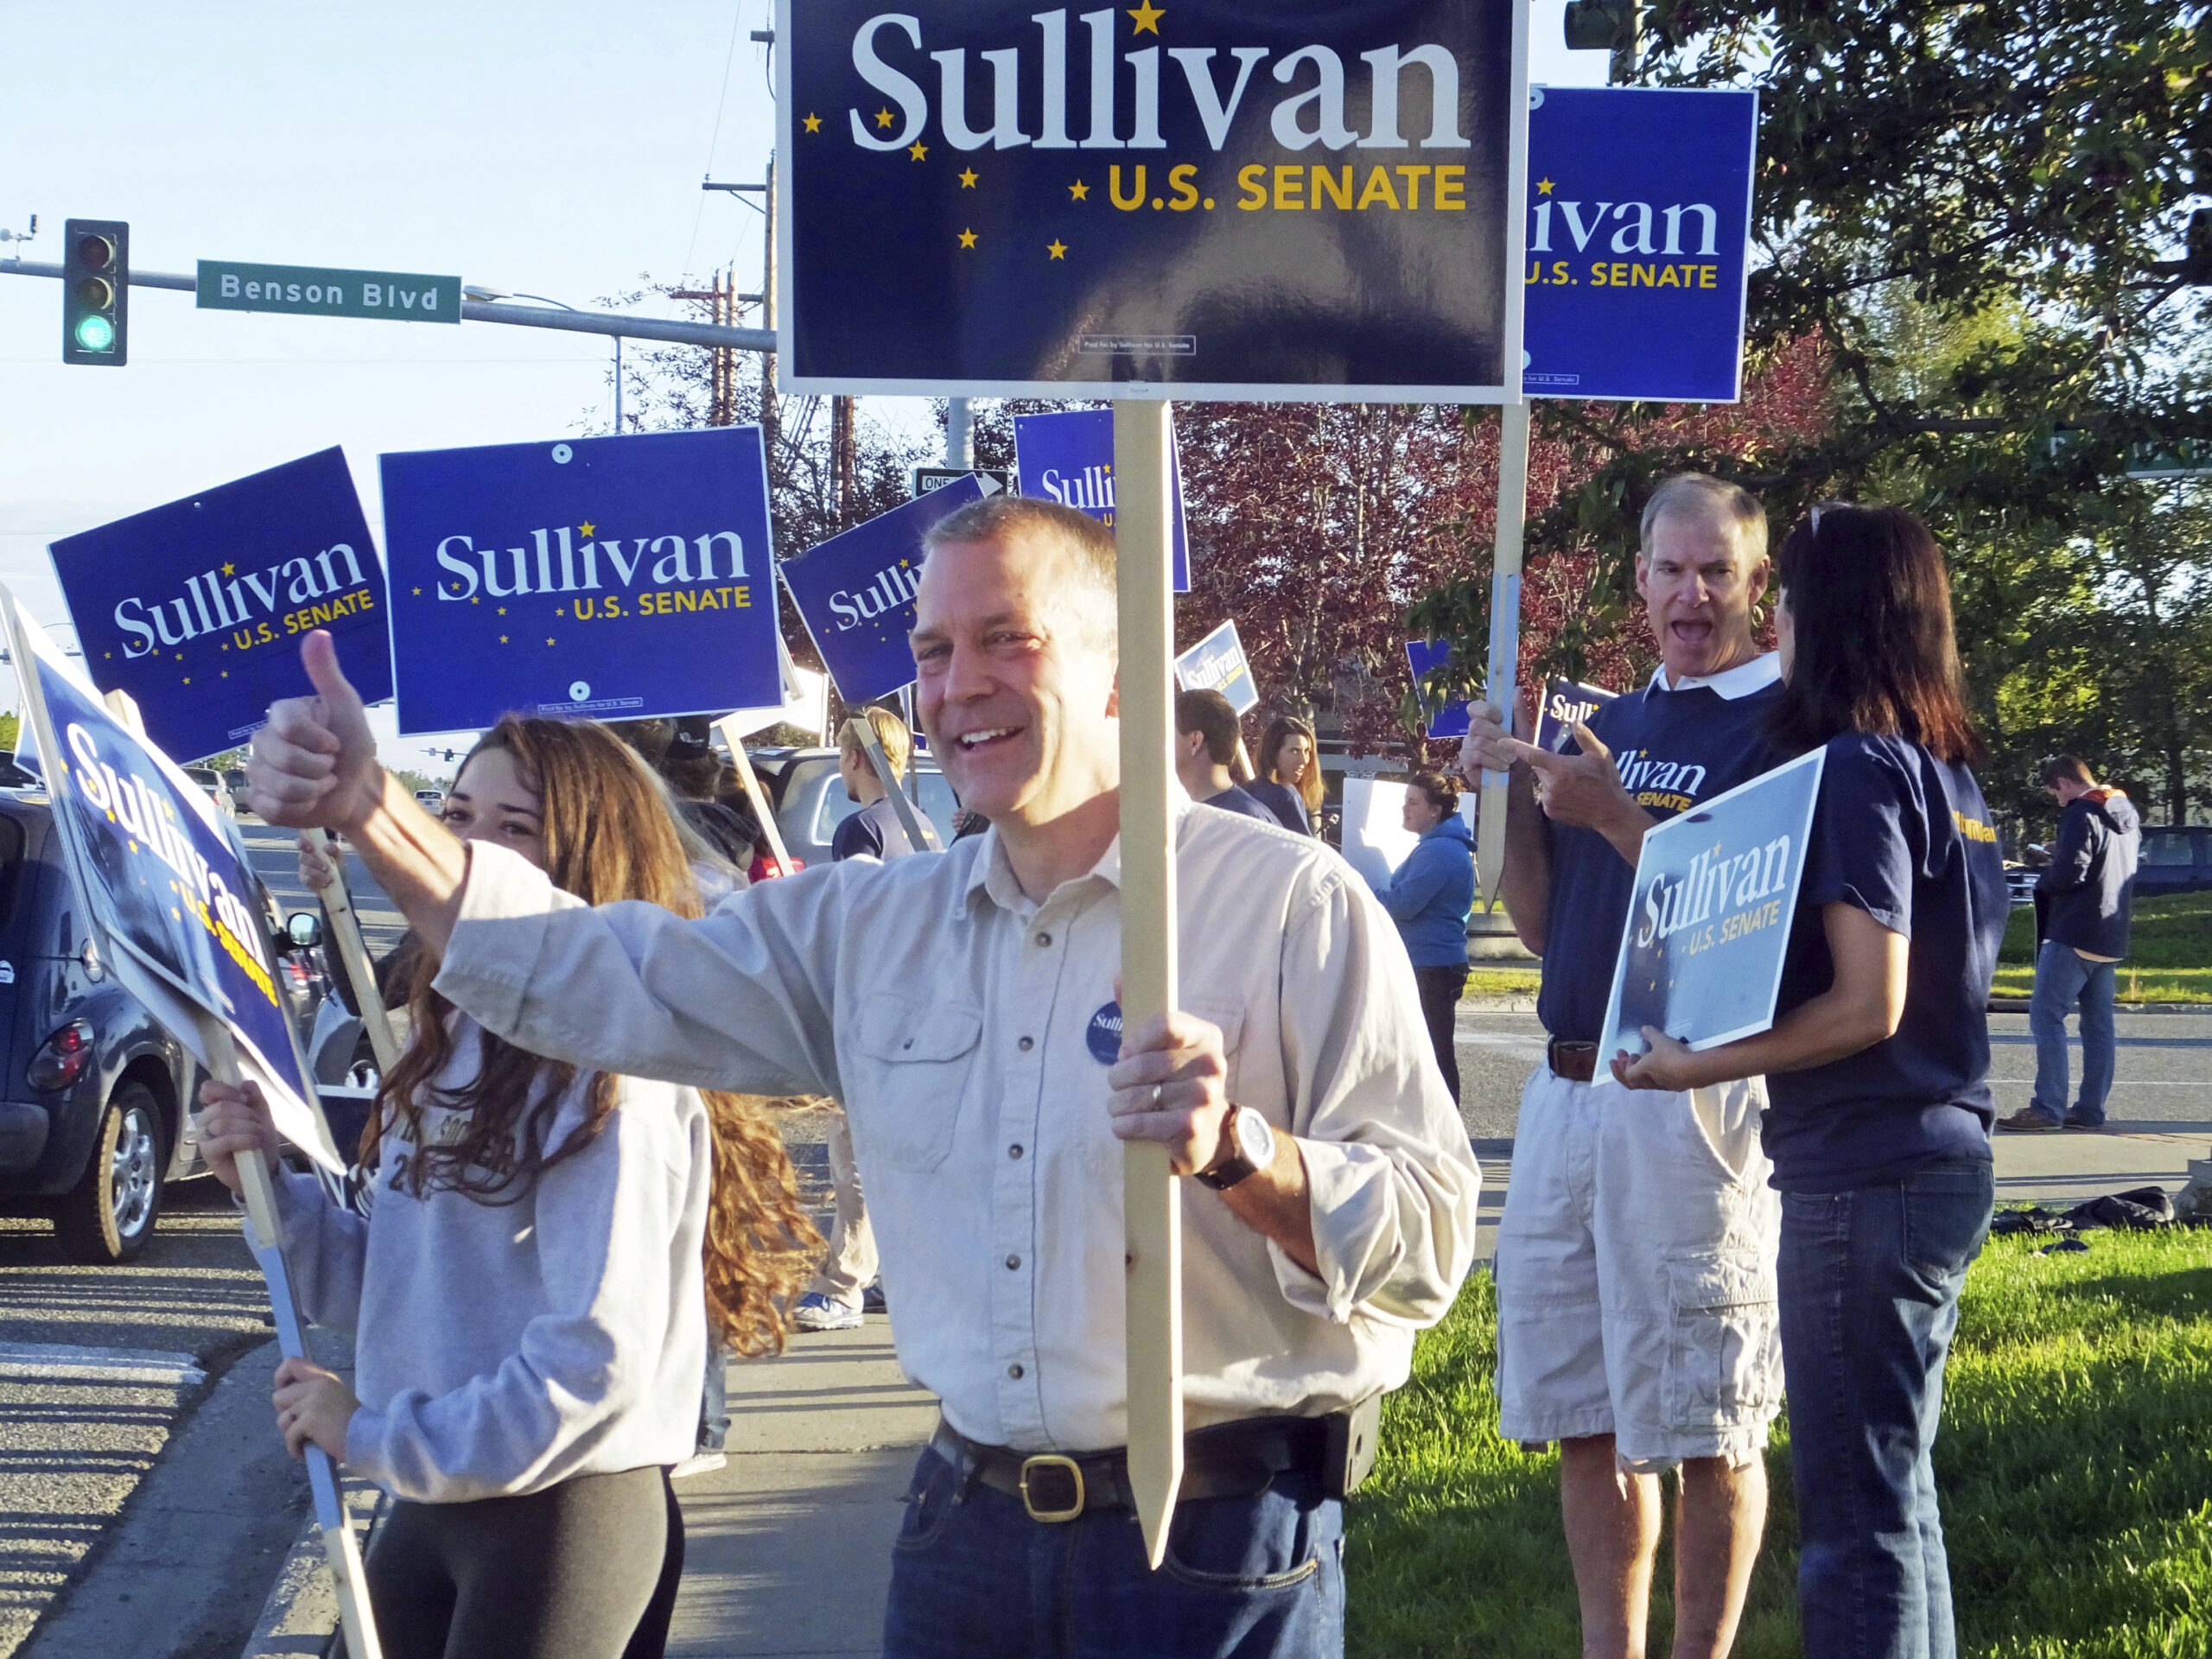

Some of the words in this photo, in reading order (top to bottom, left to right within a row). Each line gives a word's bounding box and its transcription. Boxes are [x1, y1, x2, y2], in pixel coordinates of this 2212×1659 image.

[849, 2, 1471, 151] Sullivan
[1109, 163, 1215, 211] U.S.
[1236, 163, 1467, 211] SENATE
[1526, 178, 1720, 256] ivan
[220, 274, 343, 305] Benson
[362, 283, 438, 311] Blvd
[1590, 262, 1718, 289] SENATE
[1041, 463, 1116, 509] Sulli
[435, 521, 750, 601] Sullivan
[114, 543, 368, 659] Sullivan
[232, 621, 280, 651] U.S.
[283, 588, 375, 635] SENATE
[573, 595, 630, 620] U.S.
[638, 585, 752, 616] SENATE
[829, 558, 925, 632] Sulli
[1550, 693, 1594, 723] Sull
[1616, 748, 1707, 796] llivan
[67, 722, 270, 976] Sullivan
[1637, 835, 1790, 949] Sullivan
[1689, 925, 1715, 956] U.S.
[1719, 899, 1782, 945] SENATE
